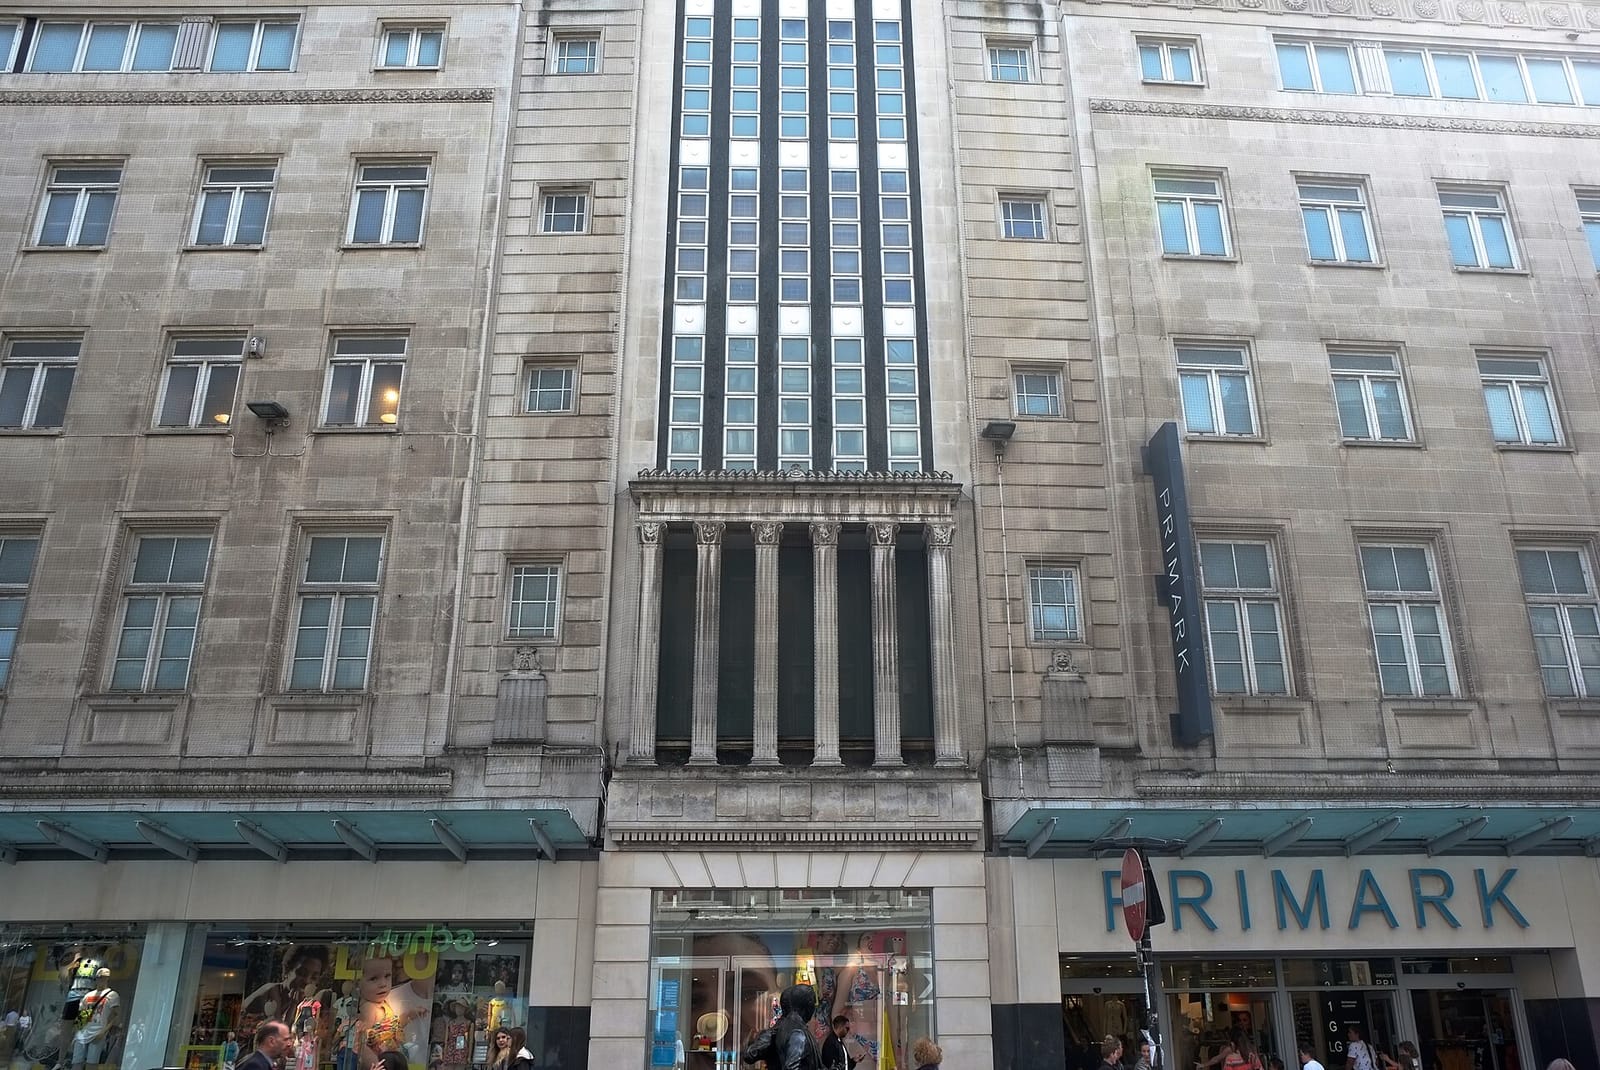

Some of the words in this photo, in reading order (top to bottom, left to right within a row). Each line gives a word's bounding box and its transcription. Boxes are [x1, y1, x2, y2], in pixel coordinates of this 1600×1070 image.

[1159, 488, 1190, 673] PRIMARK
[1327, 1001, 1333, 1013] 1
[1329, 1021, 1338, 1032] G
[1328, 1041, 1343, 1053] LG
